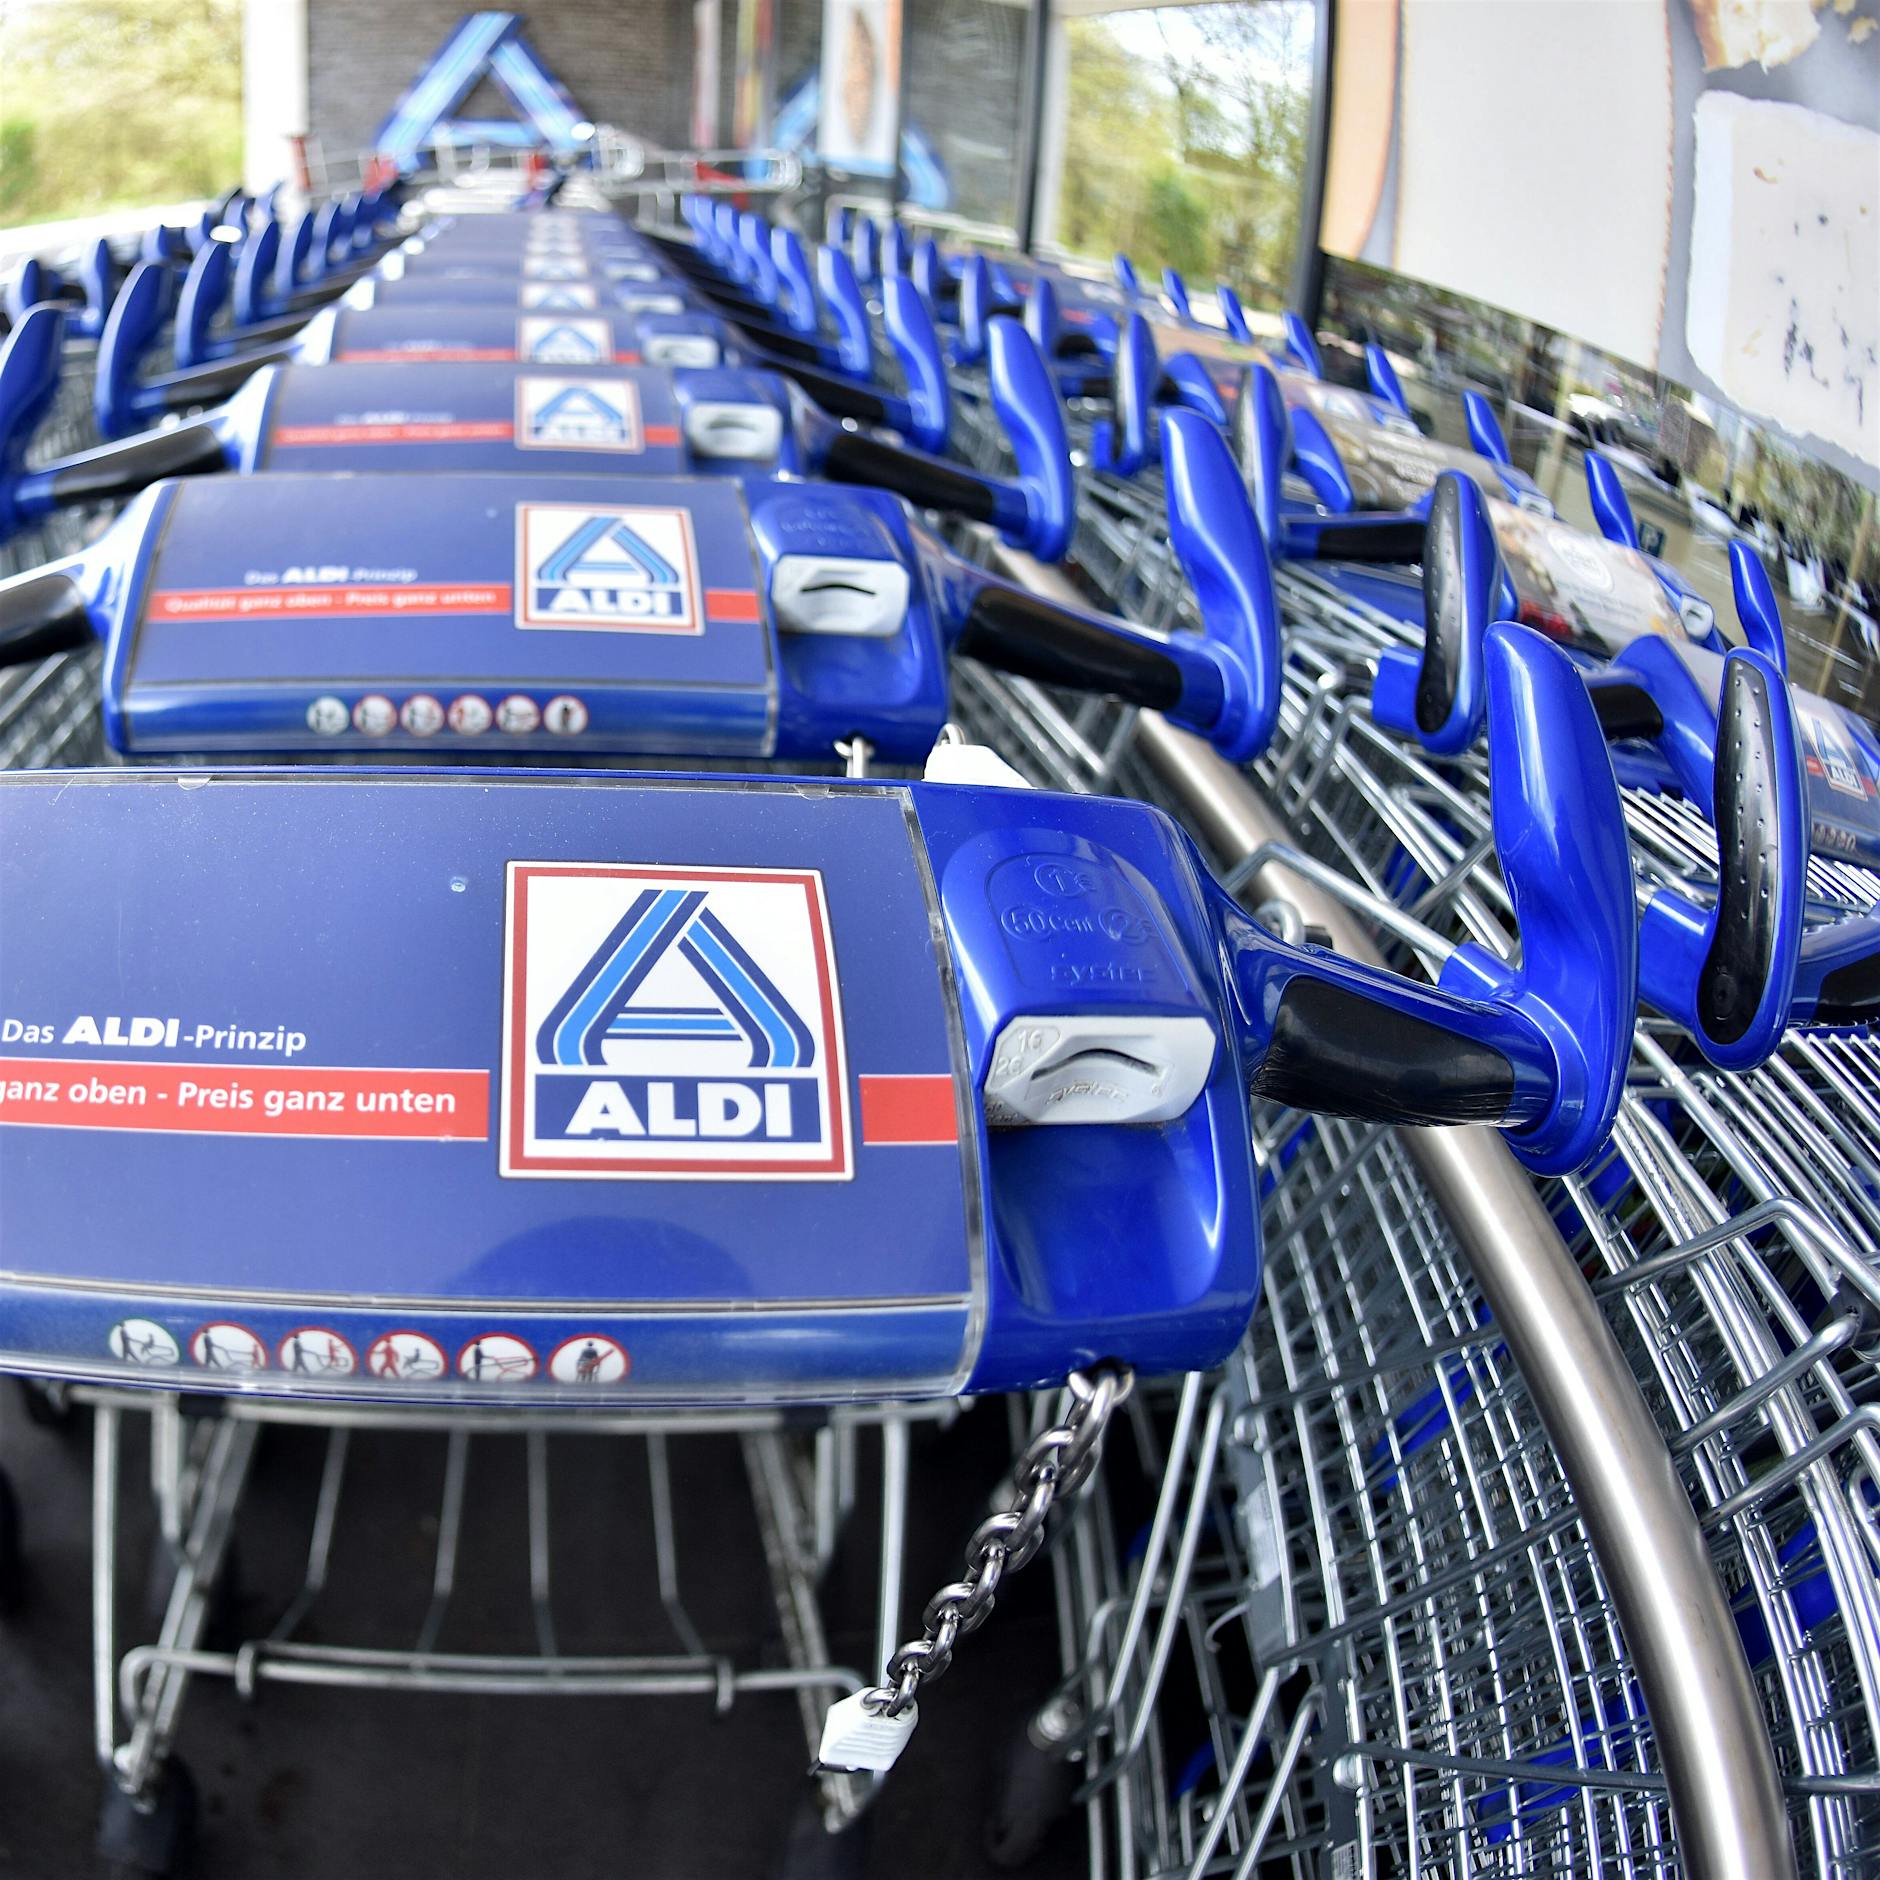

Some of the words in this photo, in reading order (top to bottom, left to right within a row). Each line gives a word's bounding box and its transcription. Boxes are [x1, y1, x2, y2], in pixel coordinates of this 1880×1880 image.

[550, 588, 671, 614] ALDI
[1, 1018, 54, 1043] Das
[68, 1076, 147, 1106] oben
[177, 1081, 254, 1110] Preis
[263, 1089, 345, 1117] ganz
[355, 1088, 456, 1114] unten
[565, 1080, 793, 1138] ALDI
